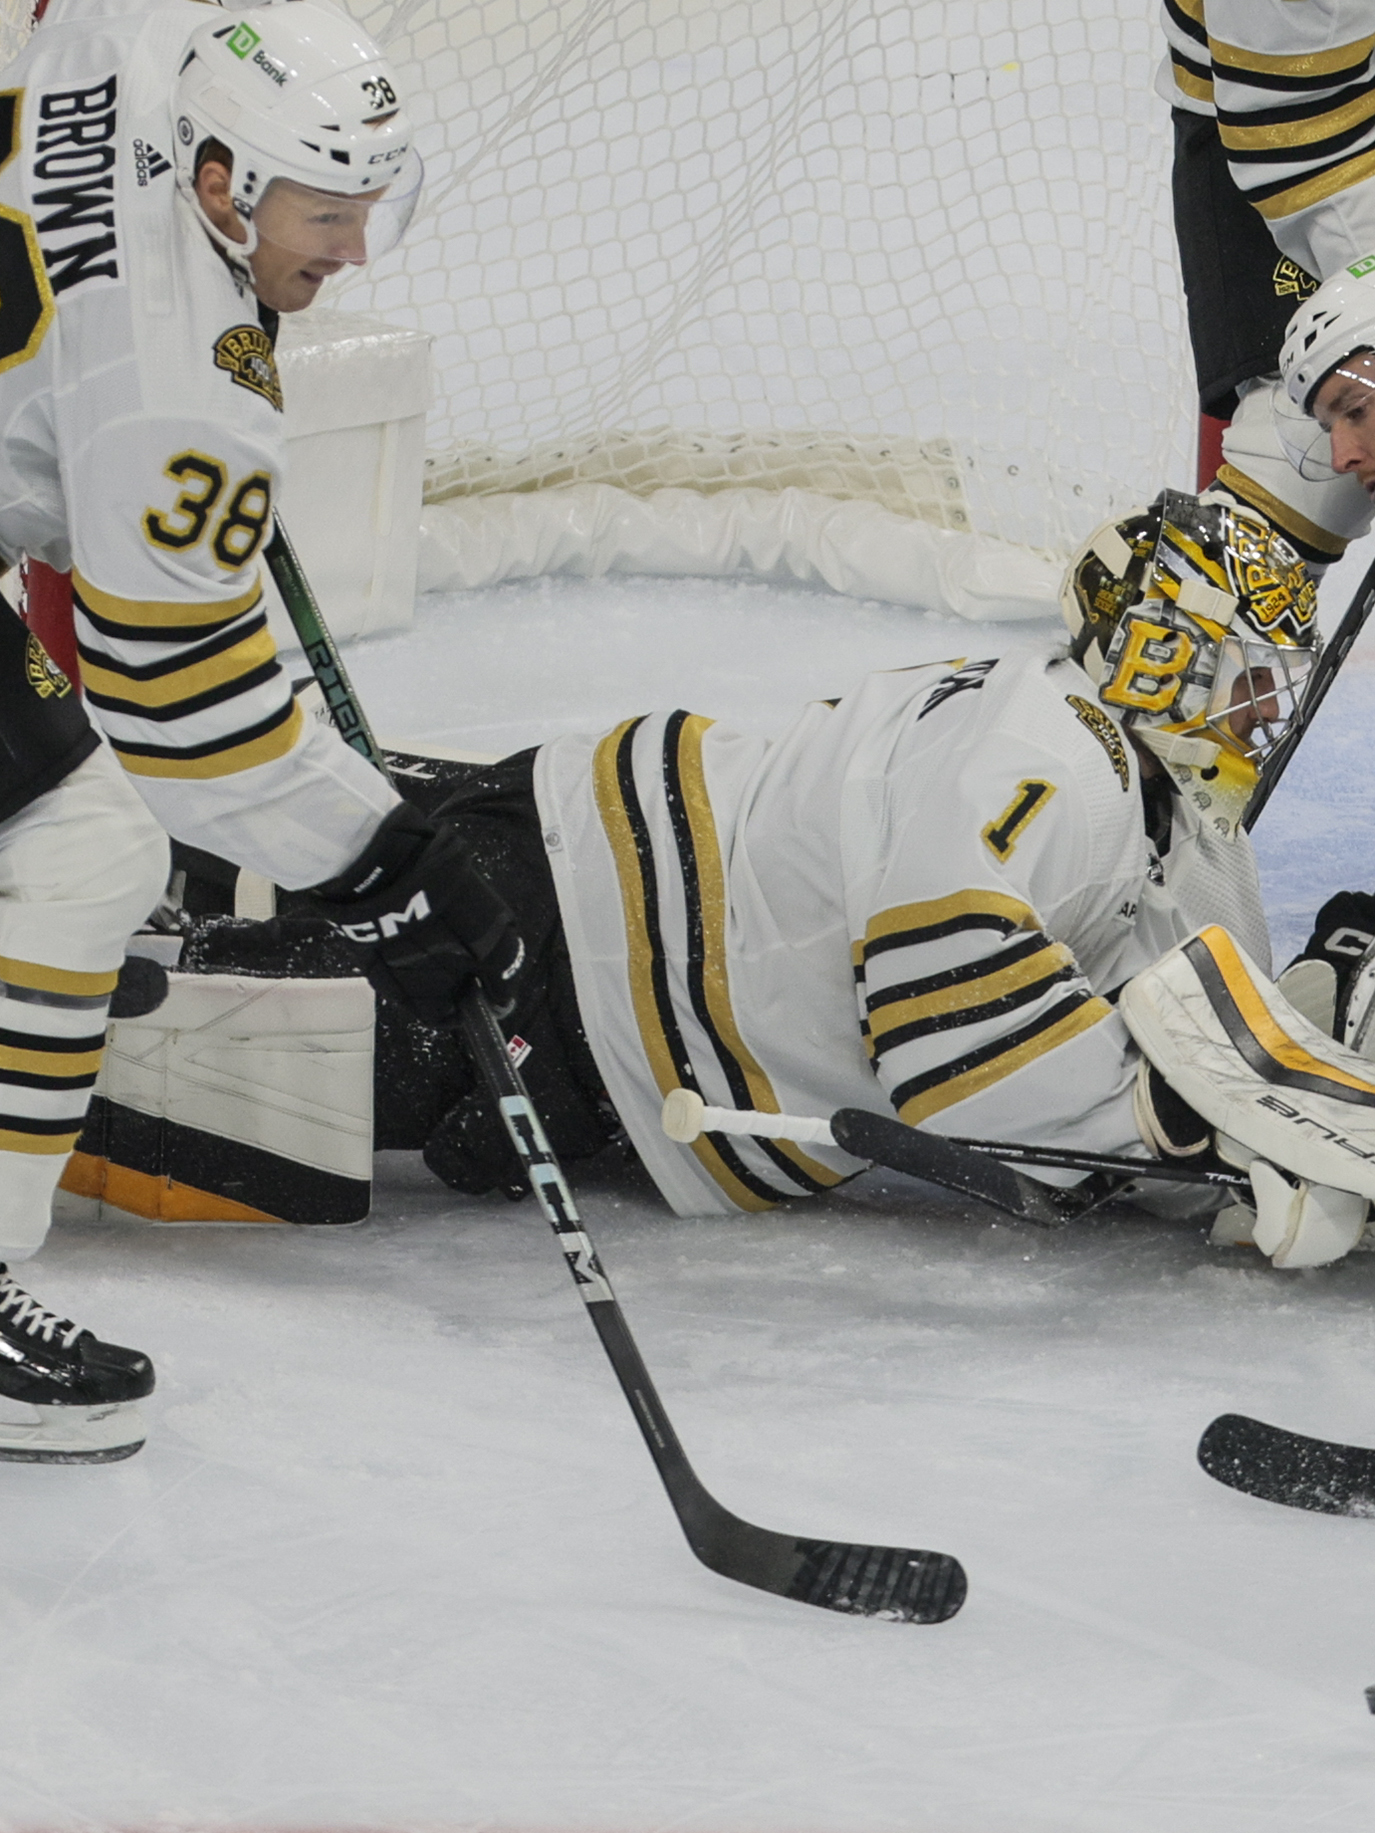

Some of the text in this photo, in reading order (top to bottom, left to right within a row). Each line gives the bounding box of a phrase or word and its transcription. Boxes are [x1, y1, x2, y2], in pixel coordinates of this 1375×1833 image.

[252, 49, 288, 88] Bank
[361, 76, 398, 111] 38
[32, 73, 119, 297] BROWN
[132, 138, 149, 188] adidas
[142, 449, 272, 572] 38
[1260, 592, 1288, 618] 1924
[1101, 617, 1196, 712] B
[980, 778, 1056, 864] 1
[353, 865, 385, 894] BROWN
